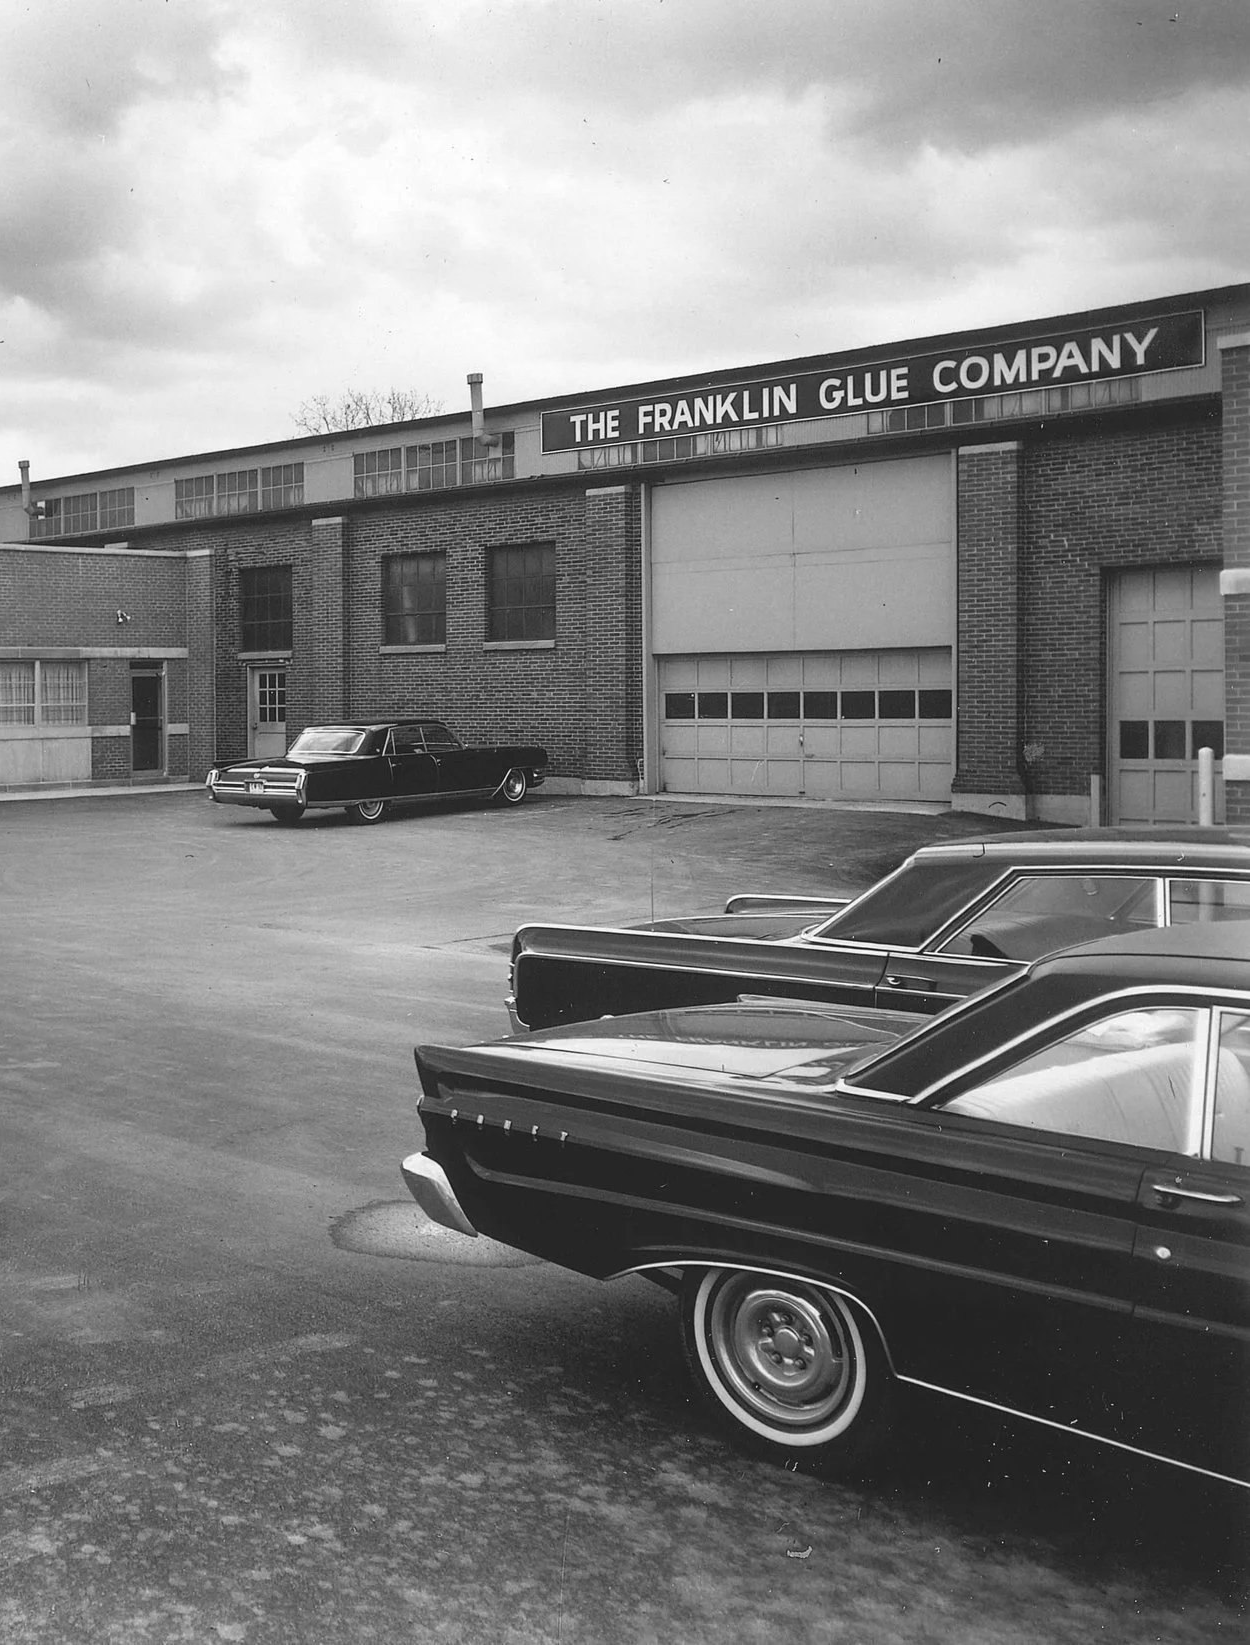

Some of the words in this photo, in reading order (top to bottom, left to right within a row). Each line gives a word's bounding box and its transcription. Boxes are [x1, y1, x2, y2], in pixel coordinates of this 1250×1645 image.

[569, 410, 620, 443] THE
[638, 383, 798, 434] FRANKLIN
[819, 366, 910, 410] GLUE
[933, 328, 1158, 393] COMPANY
